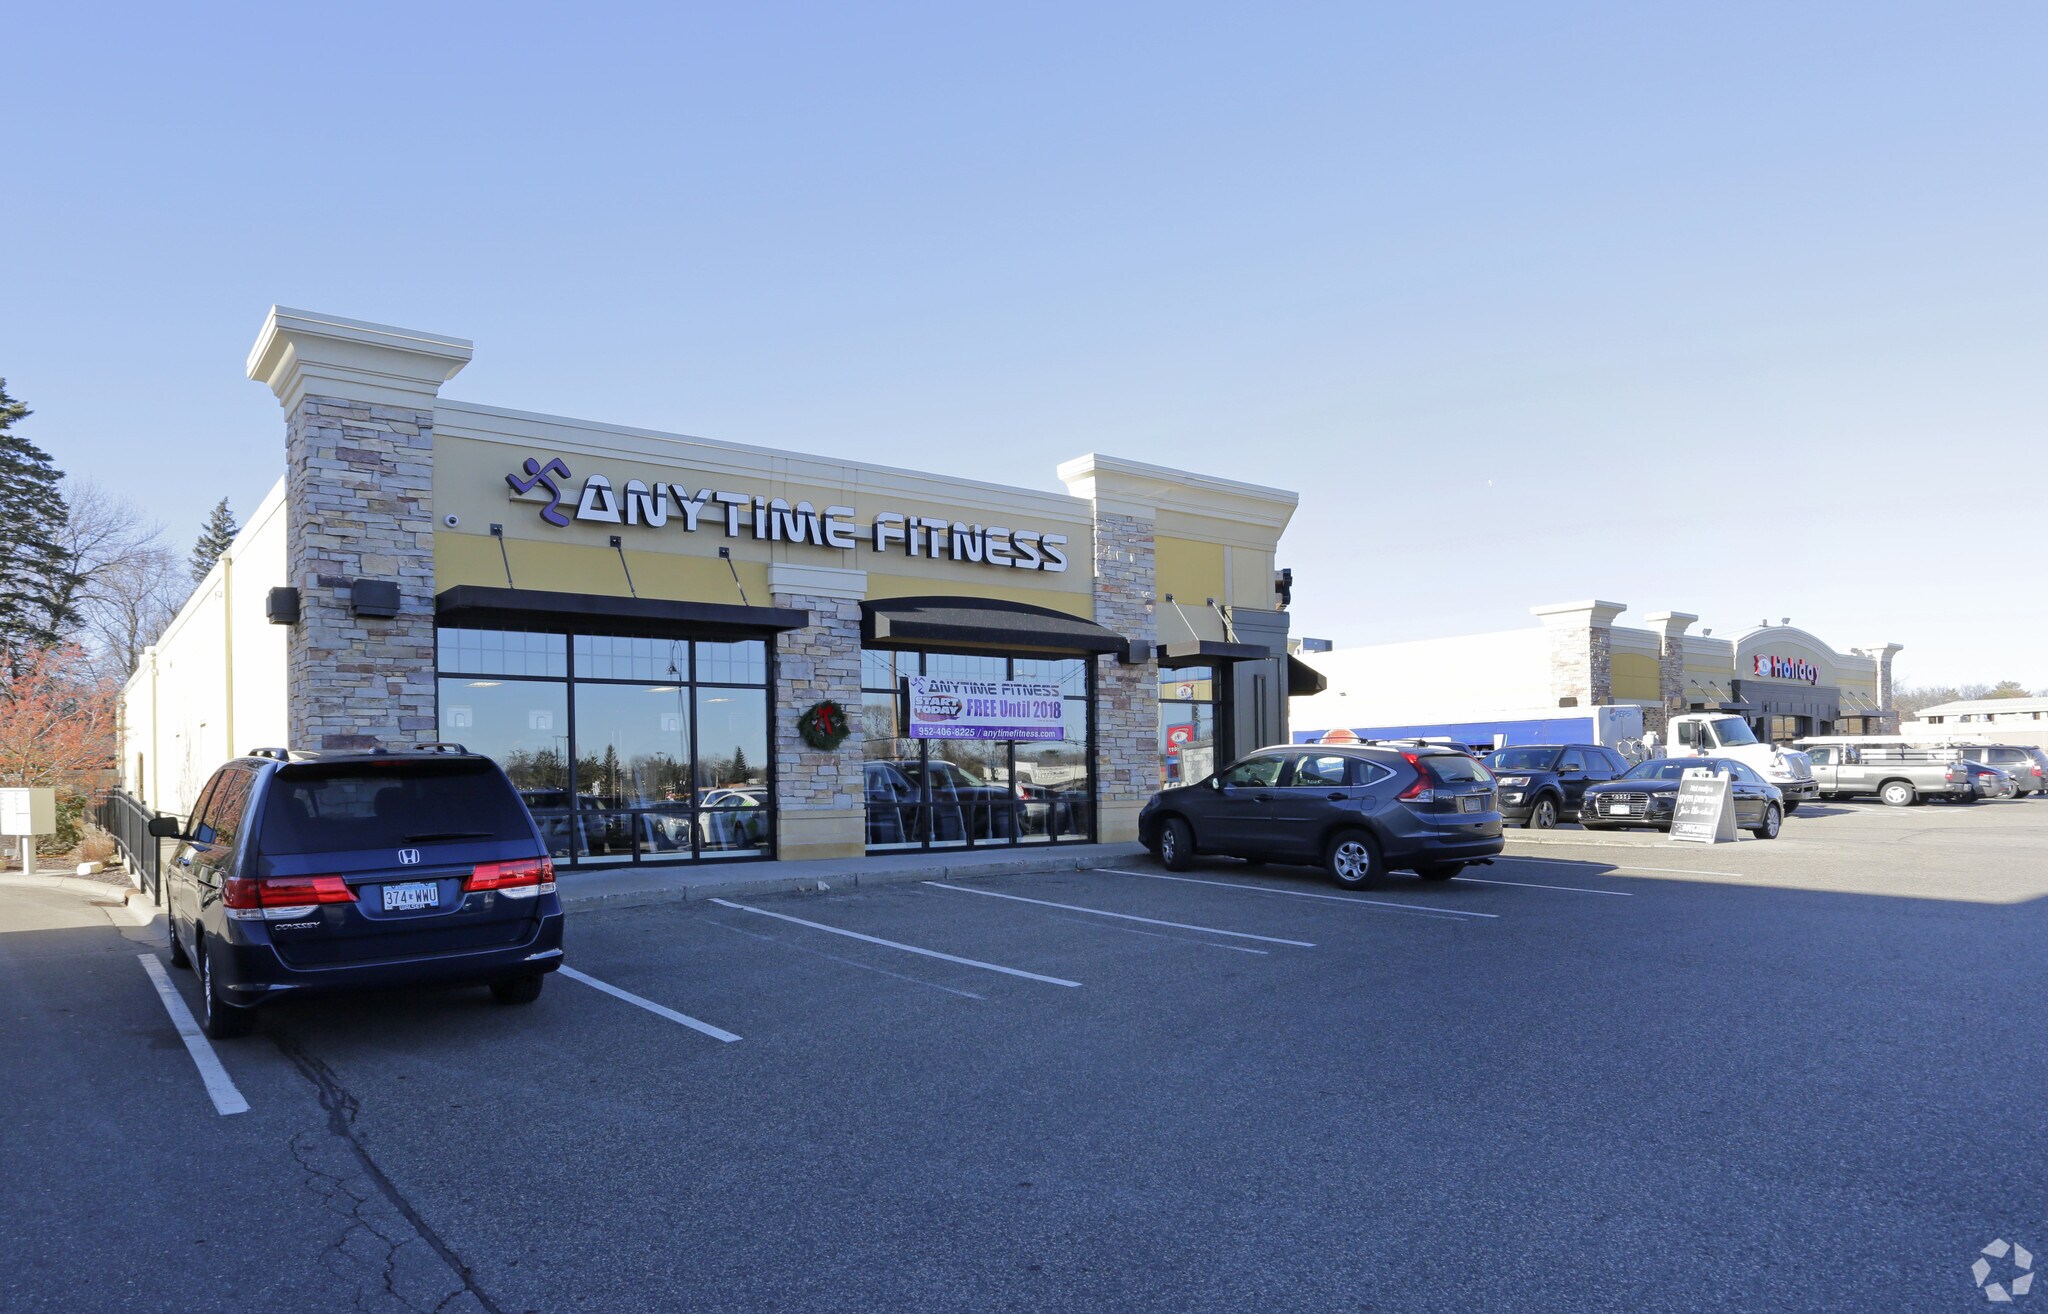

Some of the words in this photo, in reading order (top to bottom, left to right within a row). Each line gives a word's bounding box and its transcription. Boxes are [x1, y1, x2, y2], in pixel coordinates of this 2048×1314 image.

[575, 474, 857, 549] ANYTIME
[872, 511, 1069, 573] FITNESS
[1771, 655, 1821, 686] Holiday
[929, 680, 997, 695] ANYTIME
[1001, 684, 1059, 697] FITNESS
[915, 696, 959, 706] START
[915, 705, 959, 716] TODAY
[967, 699, 997, 717] FREE
[1000, 700, 1031, 718] Until
[1033, 702, 1062, 719] 2018
[919, 728, 975, 737] 952-406-8225
[983, 730, 1056, 739] anytimefitness.com
[1679, 795, 1693, 804] gym
[385, 891, 407, 905] 374
[415, 888, 437, 902] WWU
[275, 921, 321, 931] ODYSSEY
